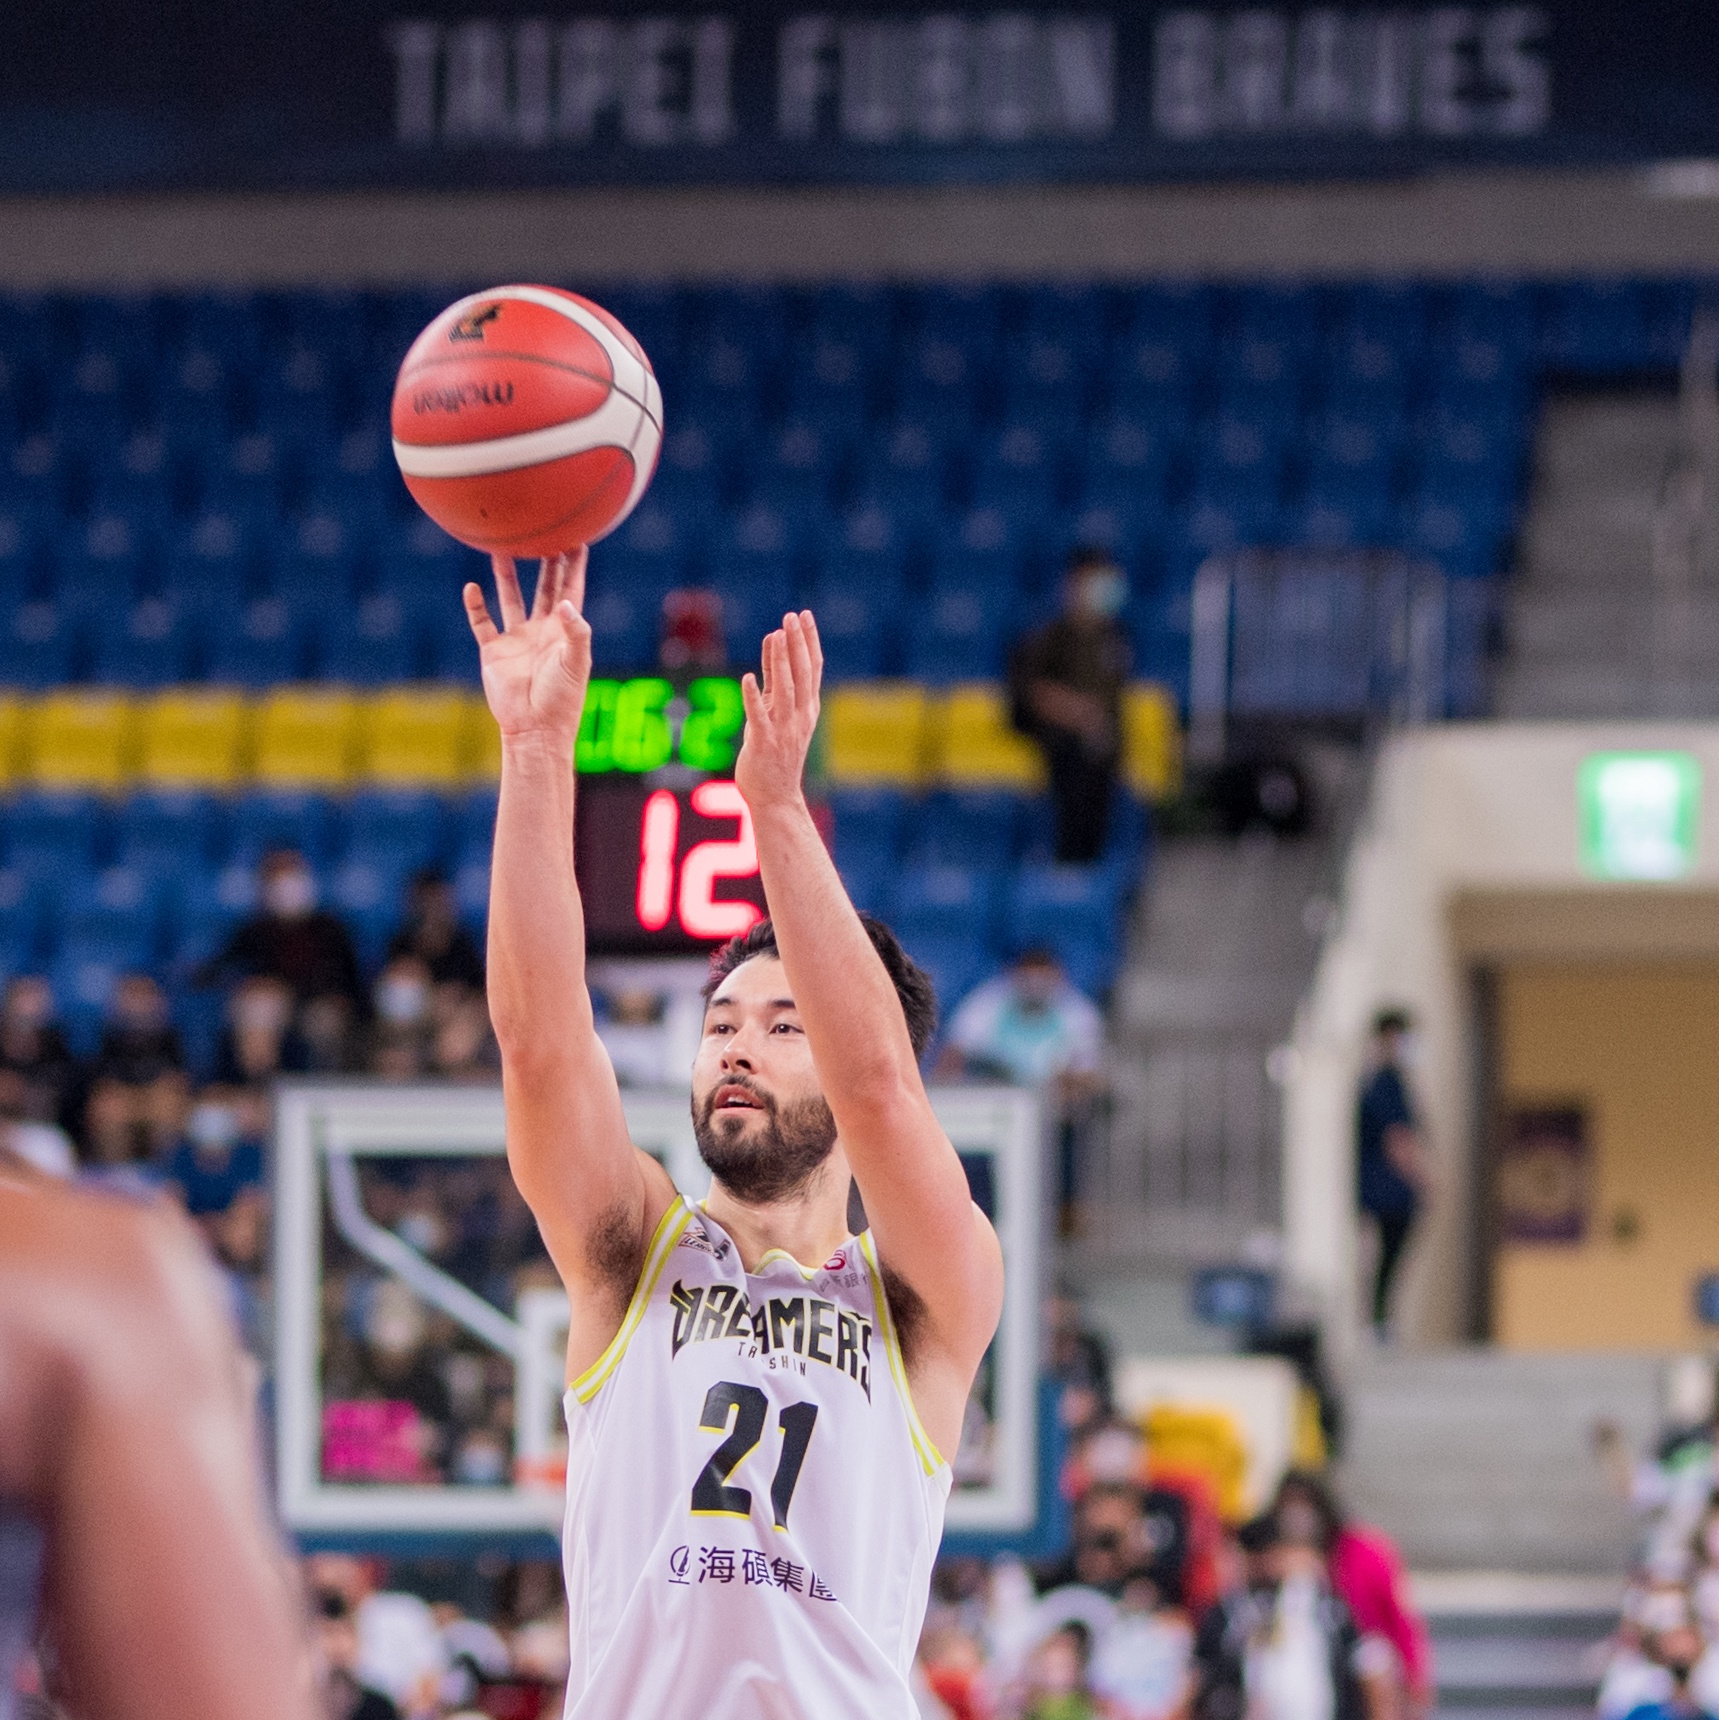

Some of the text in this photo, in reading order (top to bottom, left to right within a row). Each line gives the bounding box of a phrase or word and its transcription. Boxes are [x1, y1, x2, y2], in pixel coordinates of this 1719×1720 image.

[384, 8, 1552, 148] TAIPEI FUBON BRAVES
[636, 779, 764, 940] 12
[669, 1279, 872, 1407] DREAMERS
[738, 1341, 807, 1377] TASHIN
[689, 1380, 820, 1534] 21
